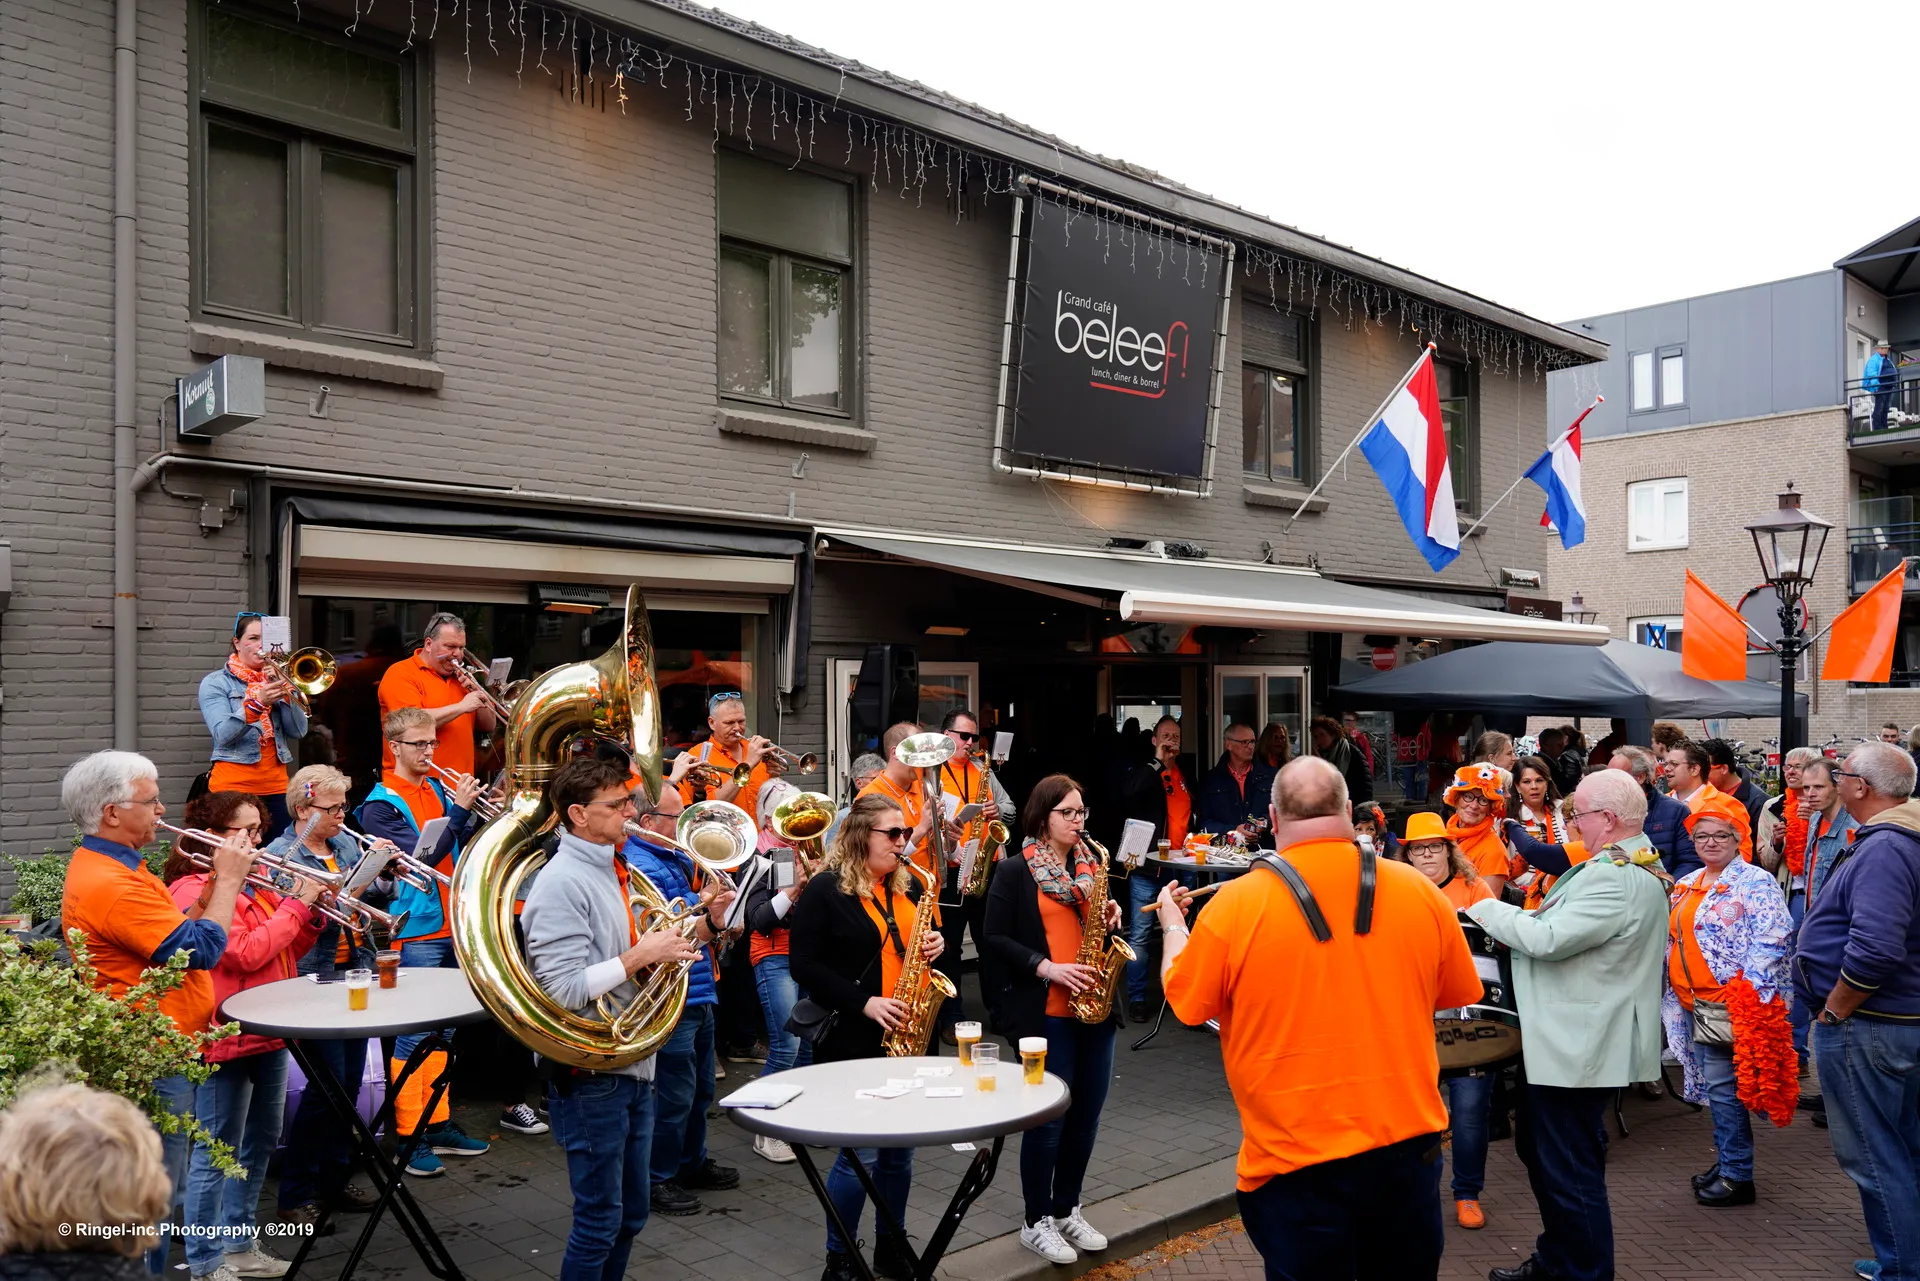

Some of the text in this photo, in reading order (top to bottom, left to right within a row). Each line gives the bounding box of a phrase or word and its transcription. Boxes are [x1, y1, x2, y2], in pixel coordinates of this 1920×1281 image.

[1064, 291, 1111, 315] Grand café
[1055, 289, 1189, 385] beleef!
[184, 368, 214, 410] Kornuit
[1091, 366, 1160, 389] lunch, diner & borrel
